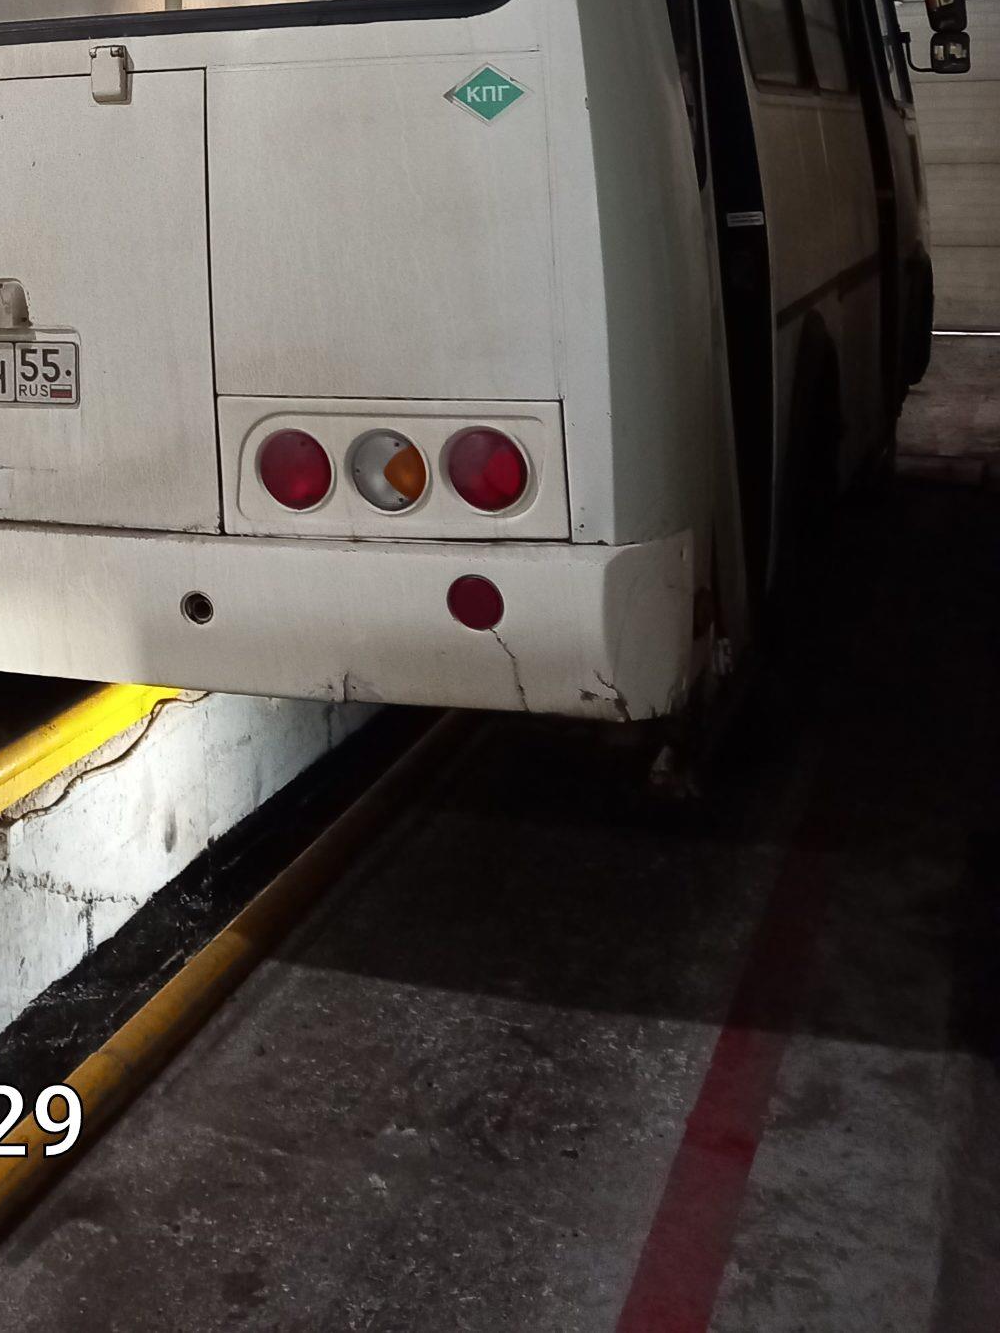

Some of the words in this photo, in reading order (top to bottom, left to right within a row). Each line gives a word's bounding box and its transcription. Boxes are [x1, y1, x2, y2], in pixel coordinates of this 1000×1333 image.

[466, 84, 509, 103] КПГ
[20, 348, 61, 382] 55
[18, 384, 49, 397] RUS
